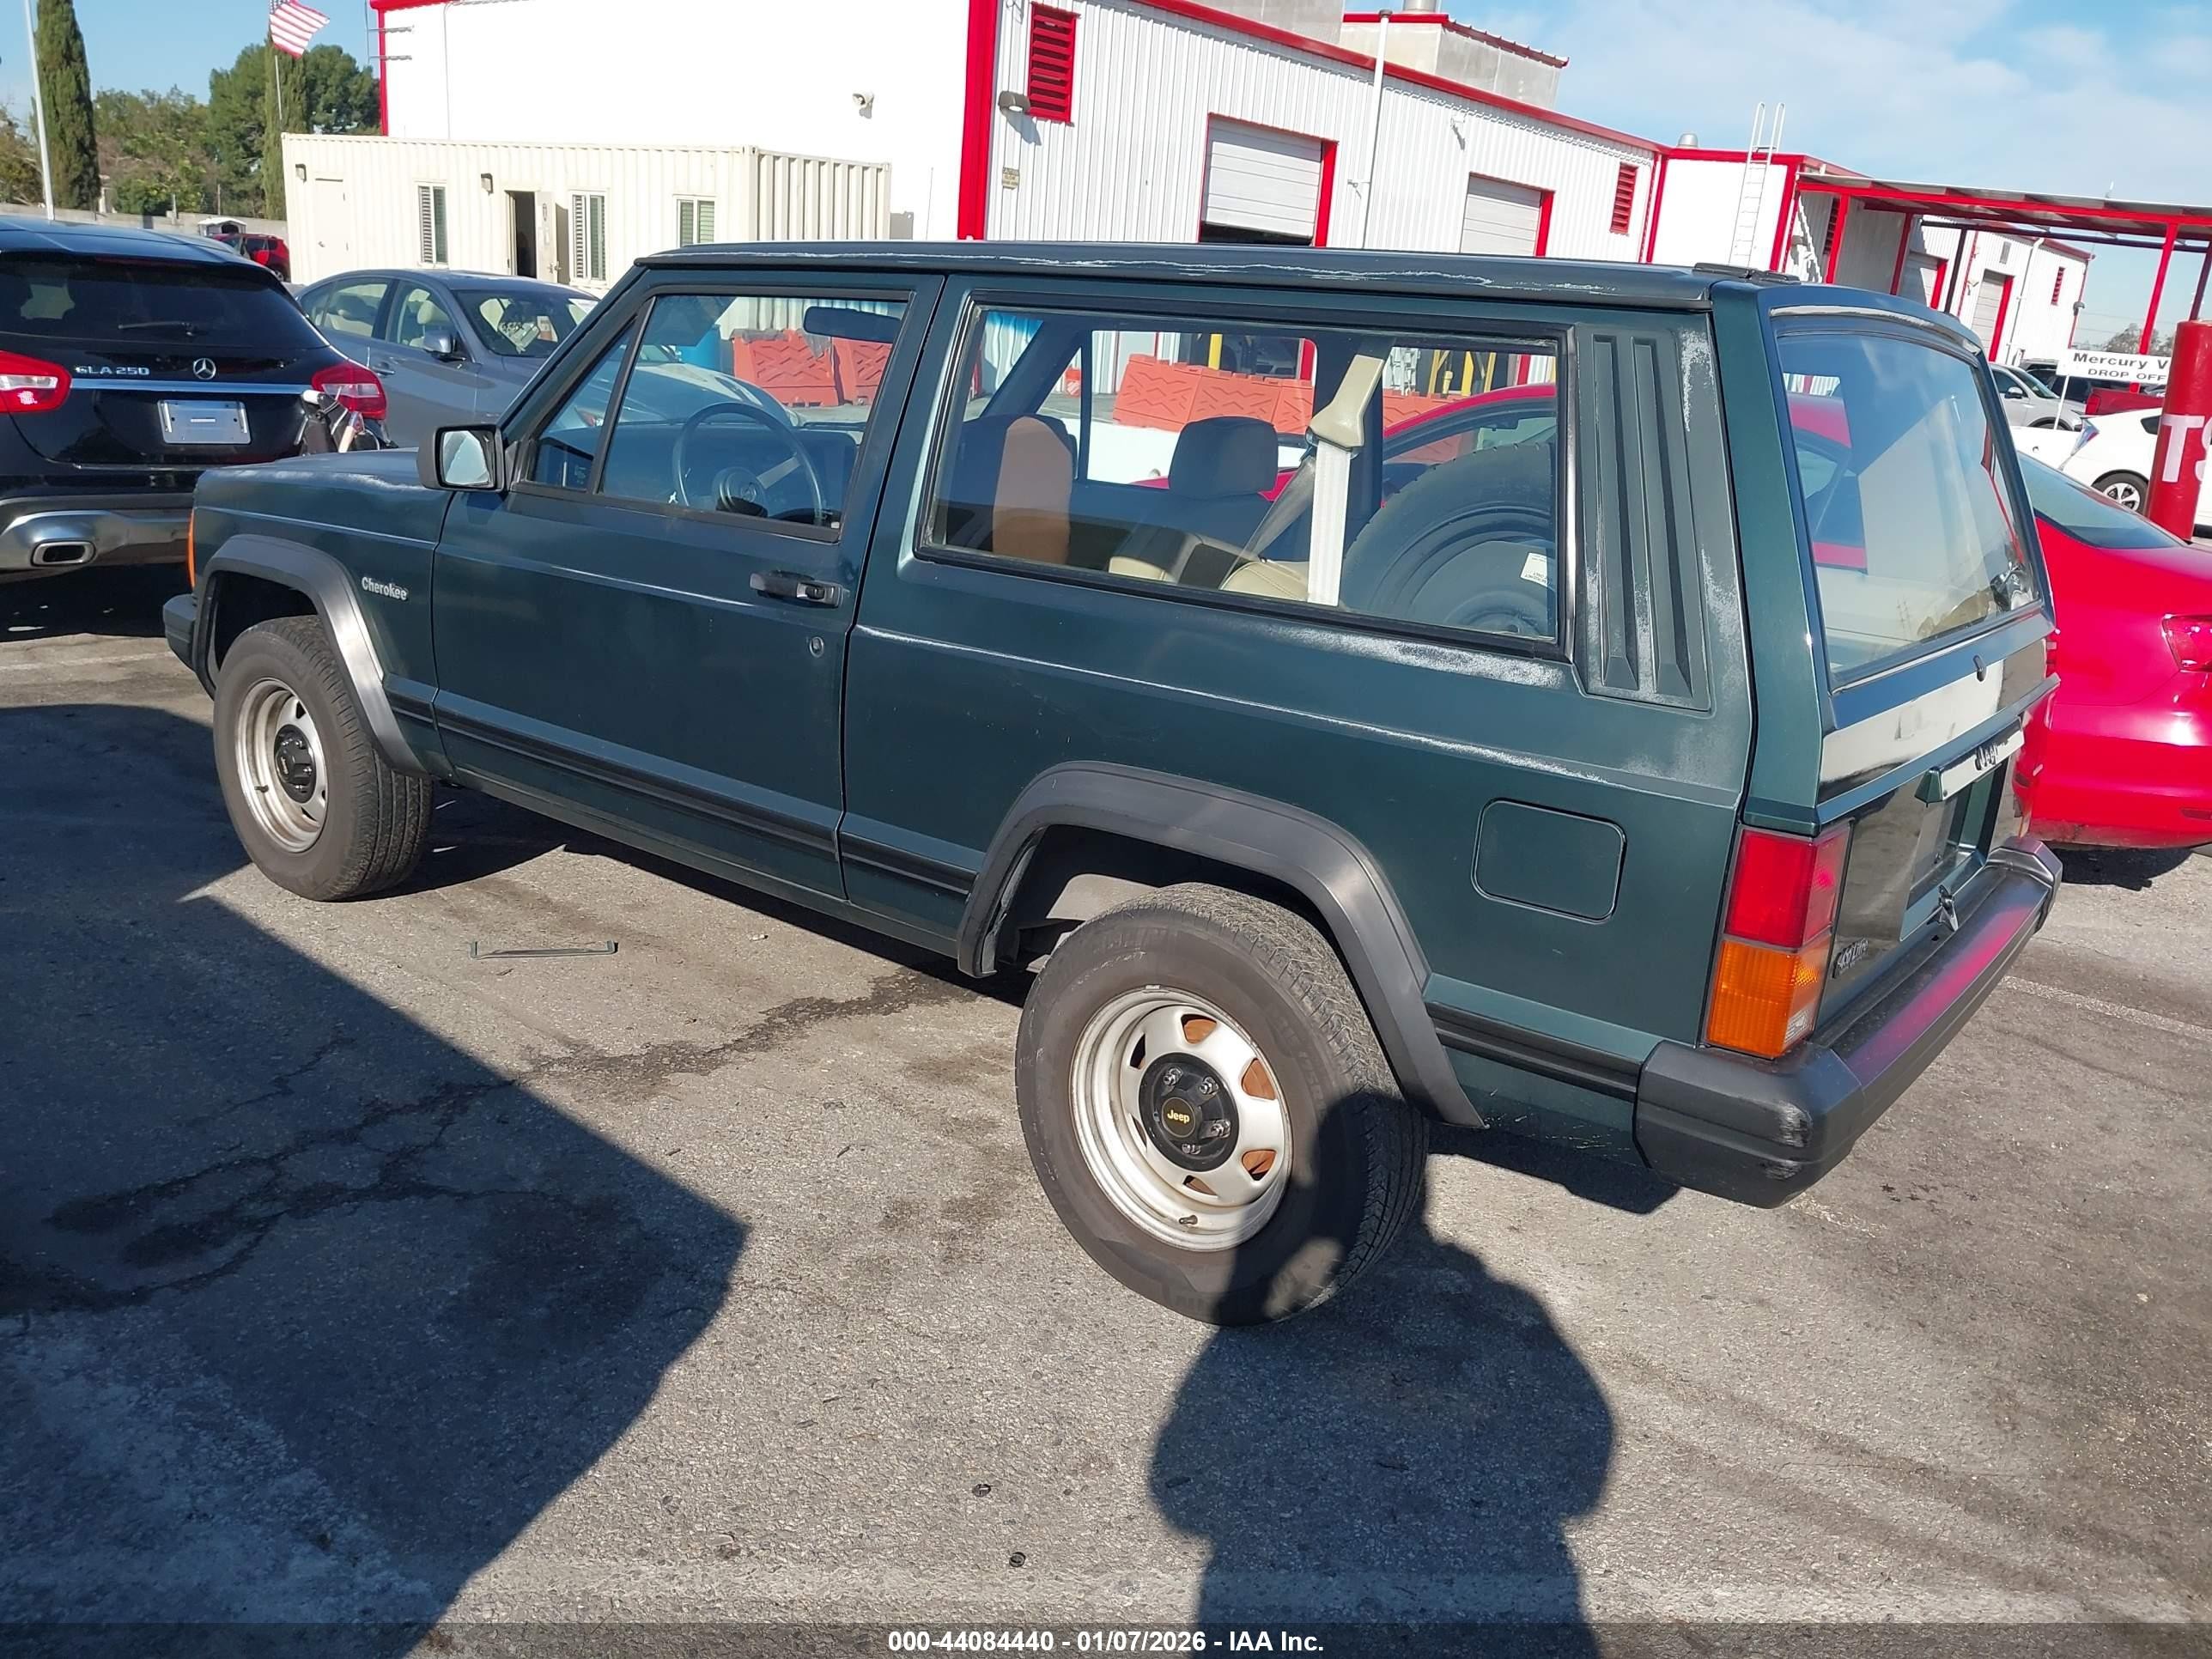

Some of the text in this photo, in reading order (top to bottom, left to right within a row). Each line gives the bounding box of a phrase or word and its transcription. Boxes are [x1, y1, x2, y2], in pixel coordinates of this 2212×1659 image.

[2073, 352, 2148, 370] Mercury
[75, 366, 150, 375] GLA 250
[2087, 368, 2167, 381] DROP OFF
[362, 576, 408, 601] Cherokee
[1167, 1109, 1190, 1124] Jeep
